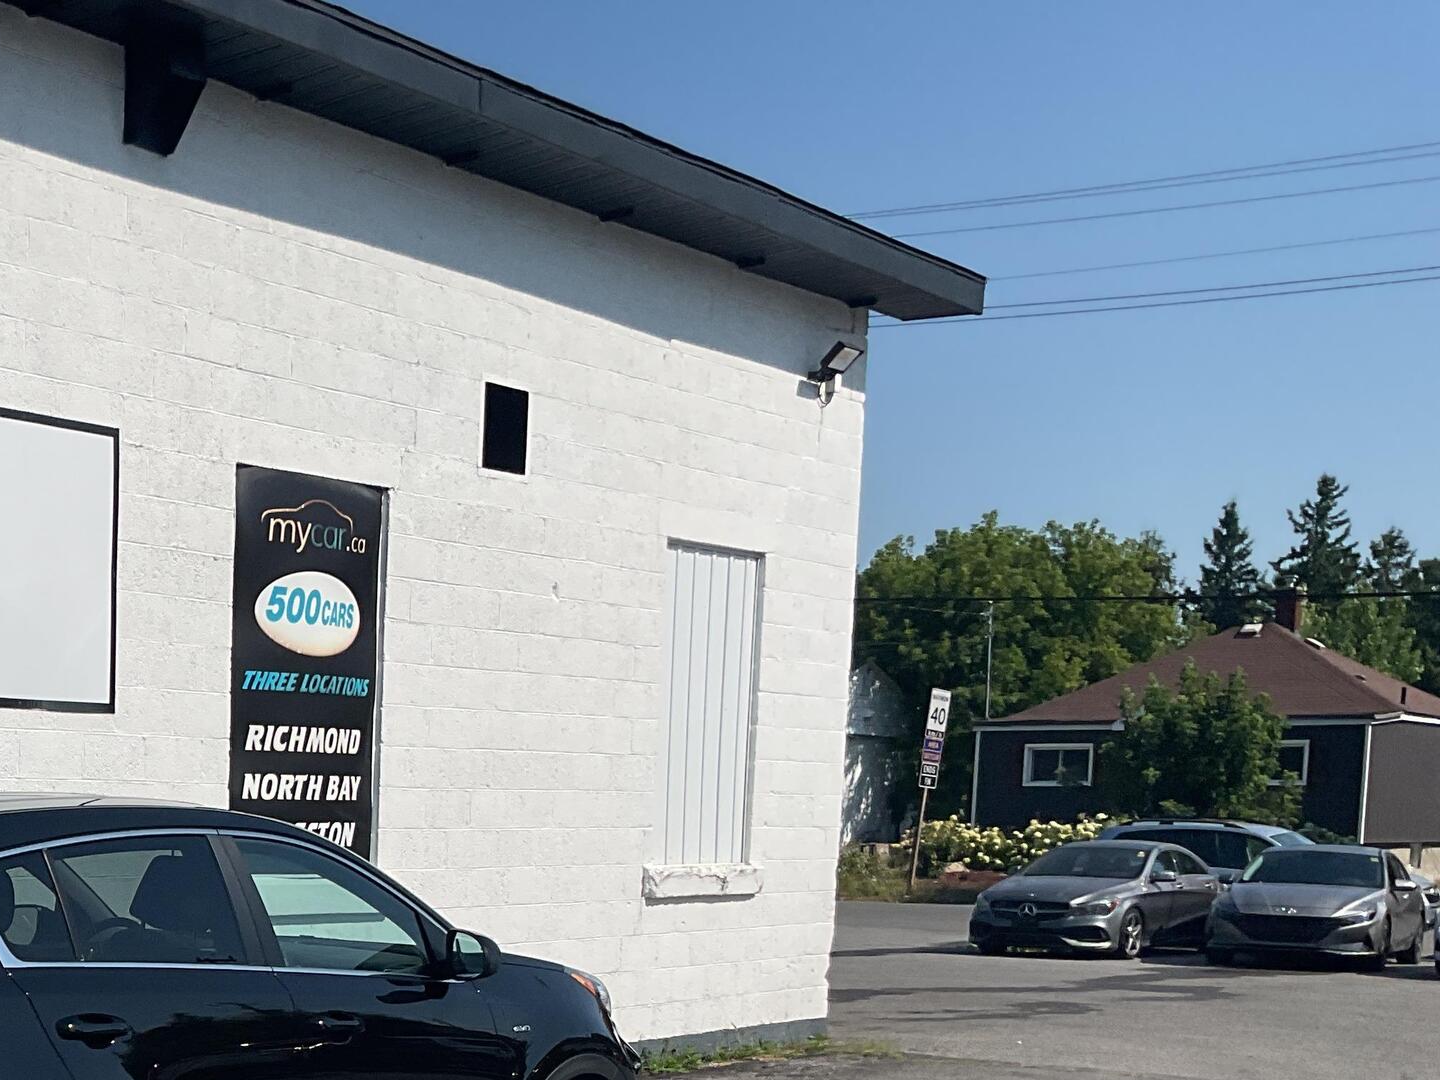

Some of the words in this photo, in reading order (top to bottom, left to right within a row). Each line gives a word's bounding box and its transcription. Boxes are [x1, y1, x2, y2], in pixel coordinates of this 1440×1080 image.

[268, 517, 366, 553] mycar.ca
[242, 670, 299, 692] THREE
[300, 674, 370, 697] LOCATIONS
[931, 707, 946, 725] 40
[245, 725, 361, 755] RICHMOND
[242, 773, 323, 801] NORTH
[326, 775, 361, 801] BAY
